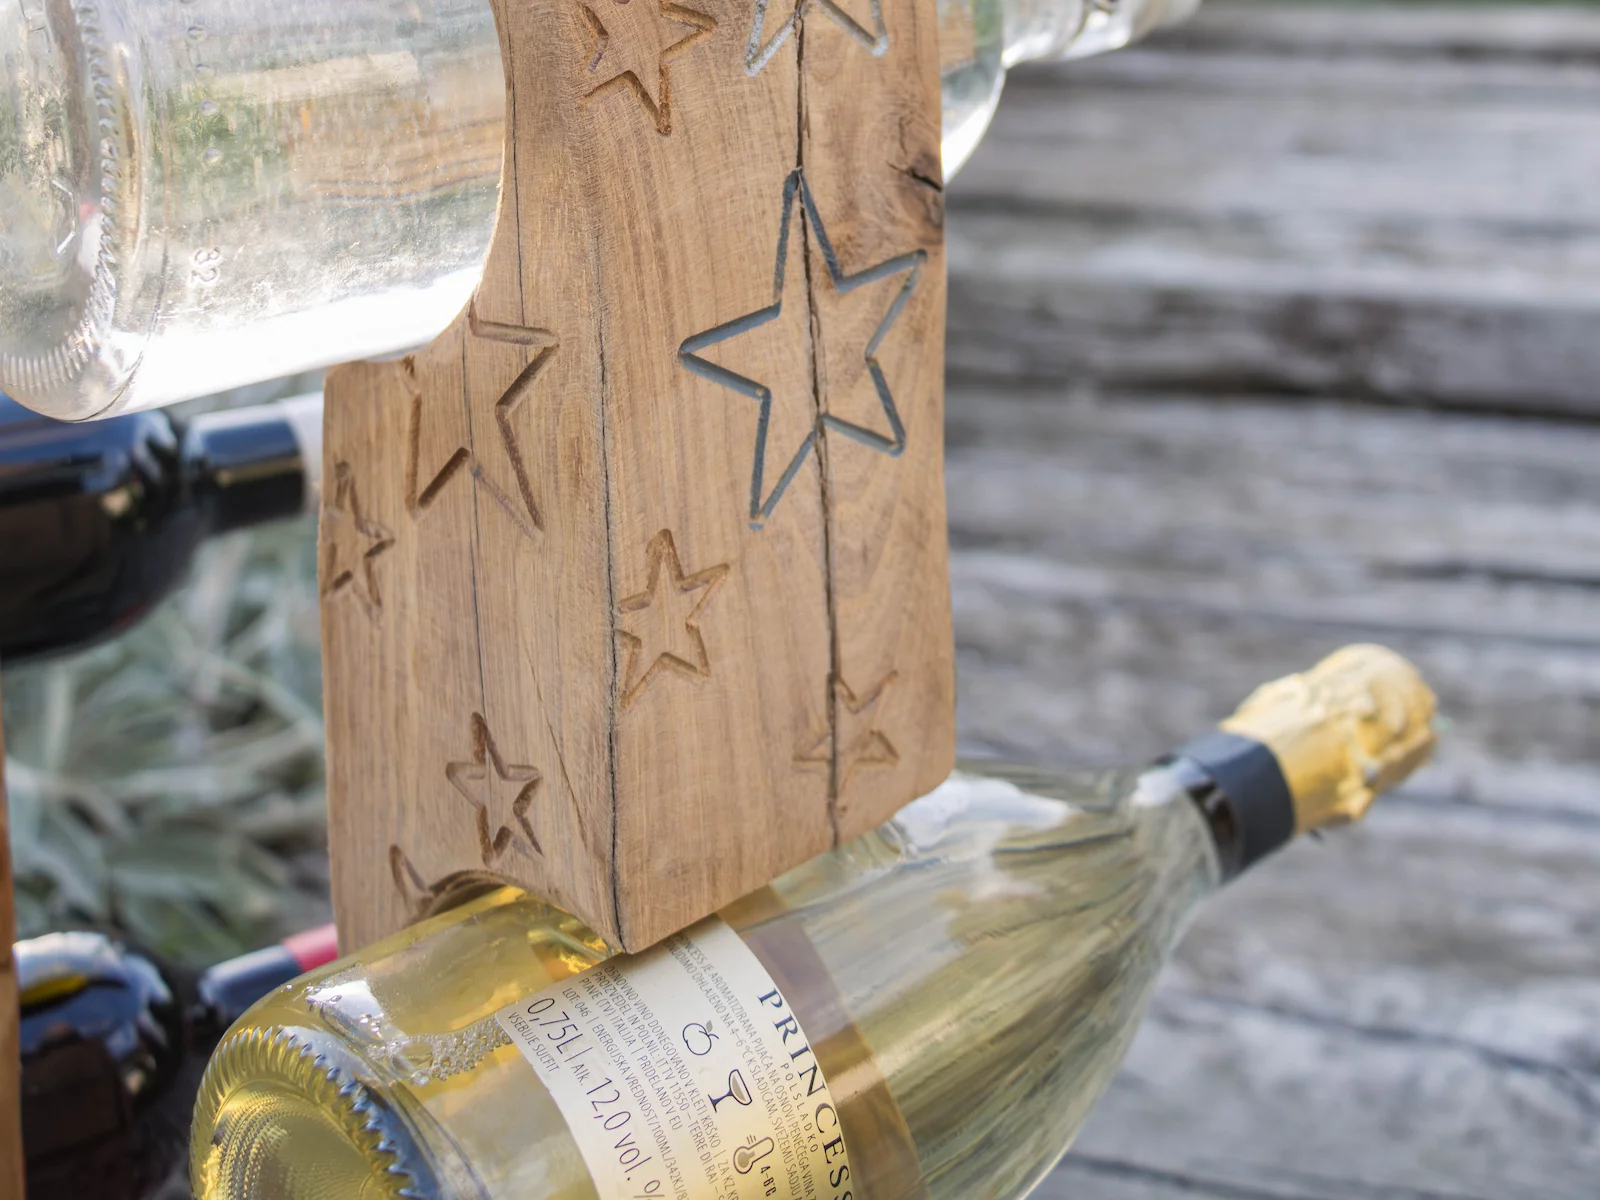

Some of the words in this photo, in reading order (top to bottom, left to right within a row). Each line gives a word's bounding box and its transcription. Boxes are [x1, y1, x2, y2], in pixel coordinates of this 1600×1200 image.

[701, 963, 715, 974] JE
[592, 970, 632, 1016] PROIZVEDEL
[708, 972, 757, 1038] AROMATIZIRANA
[507, 1011, 541, 1046] VSEBUJE
[562, 987, 581, 1005] LOT:
[574, 1001, 593, 1017] 046
[592, 1023, 631, 1075] ENERGIJSKA
[627, 1014, 641, 1026] IN
[579, 977, 603, 1000] PIAVE
[595, 997, 617, 1017] (TV)
[610, 1015, 637, 1048] ITALIJA
[637, 1055, 672, 1108] PRIDELANO
[668, 1115, 683, 1130] EU
[634, 1024, 660, 1060] POLNIL:
[751, 1037, 774, 1072] PIJAČA
[604, 964, 639, 1001] OSNOVNO
[633, 999, 654, 1021] VINO
[647, 1019, 691, 1081] DONEGOVANO
[687, 1087, 708, 1116] KLETI
[700, 1114, 722, 1149] KRŠKO
[717, 1159, 730, 1176] ZA
[724, 1173, 736, 1190] KZ
[655, 1057, 669, 1068] IT
[662, 1067, 676, 1081] TV
[768, 1069, 781, 1087] NA
[527, 997, 583, 1055] 0,75L
[571, 1063, 590, 1087] Alk.
[586, 1077, 631, 1131] 12,0
[614, 1132, 652, 1181] vol.
[669, 1081, 690, 1112] 11550
[691, 972, 727, 1014] OHLAJENO
[720, 1011, 736, 1029] NA
[749, 1064, 778, 1119] SLADICAM,
[772, 1116, 794, 1165] SVEŽEMU
[785, 1163, 801, 1196] SADJU
[774, 1085, 796, 1121] OSNOVI
[780, 1062, 819, 1153] POLSLADKO
[687, 1120, 709, 1152] TERRE
[788, 1121, 810, 1174] PENEČEGA
[700, 1151, 713, 1165] DI
[704, 1164, 718, 1185] RAI
[802, 1170, 816, 1198] VINA
